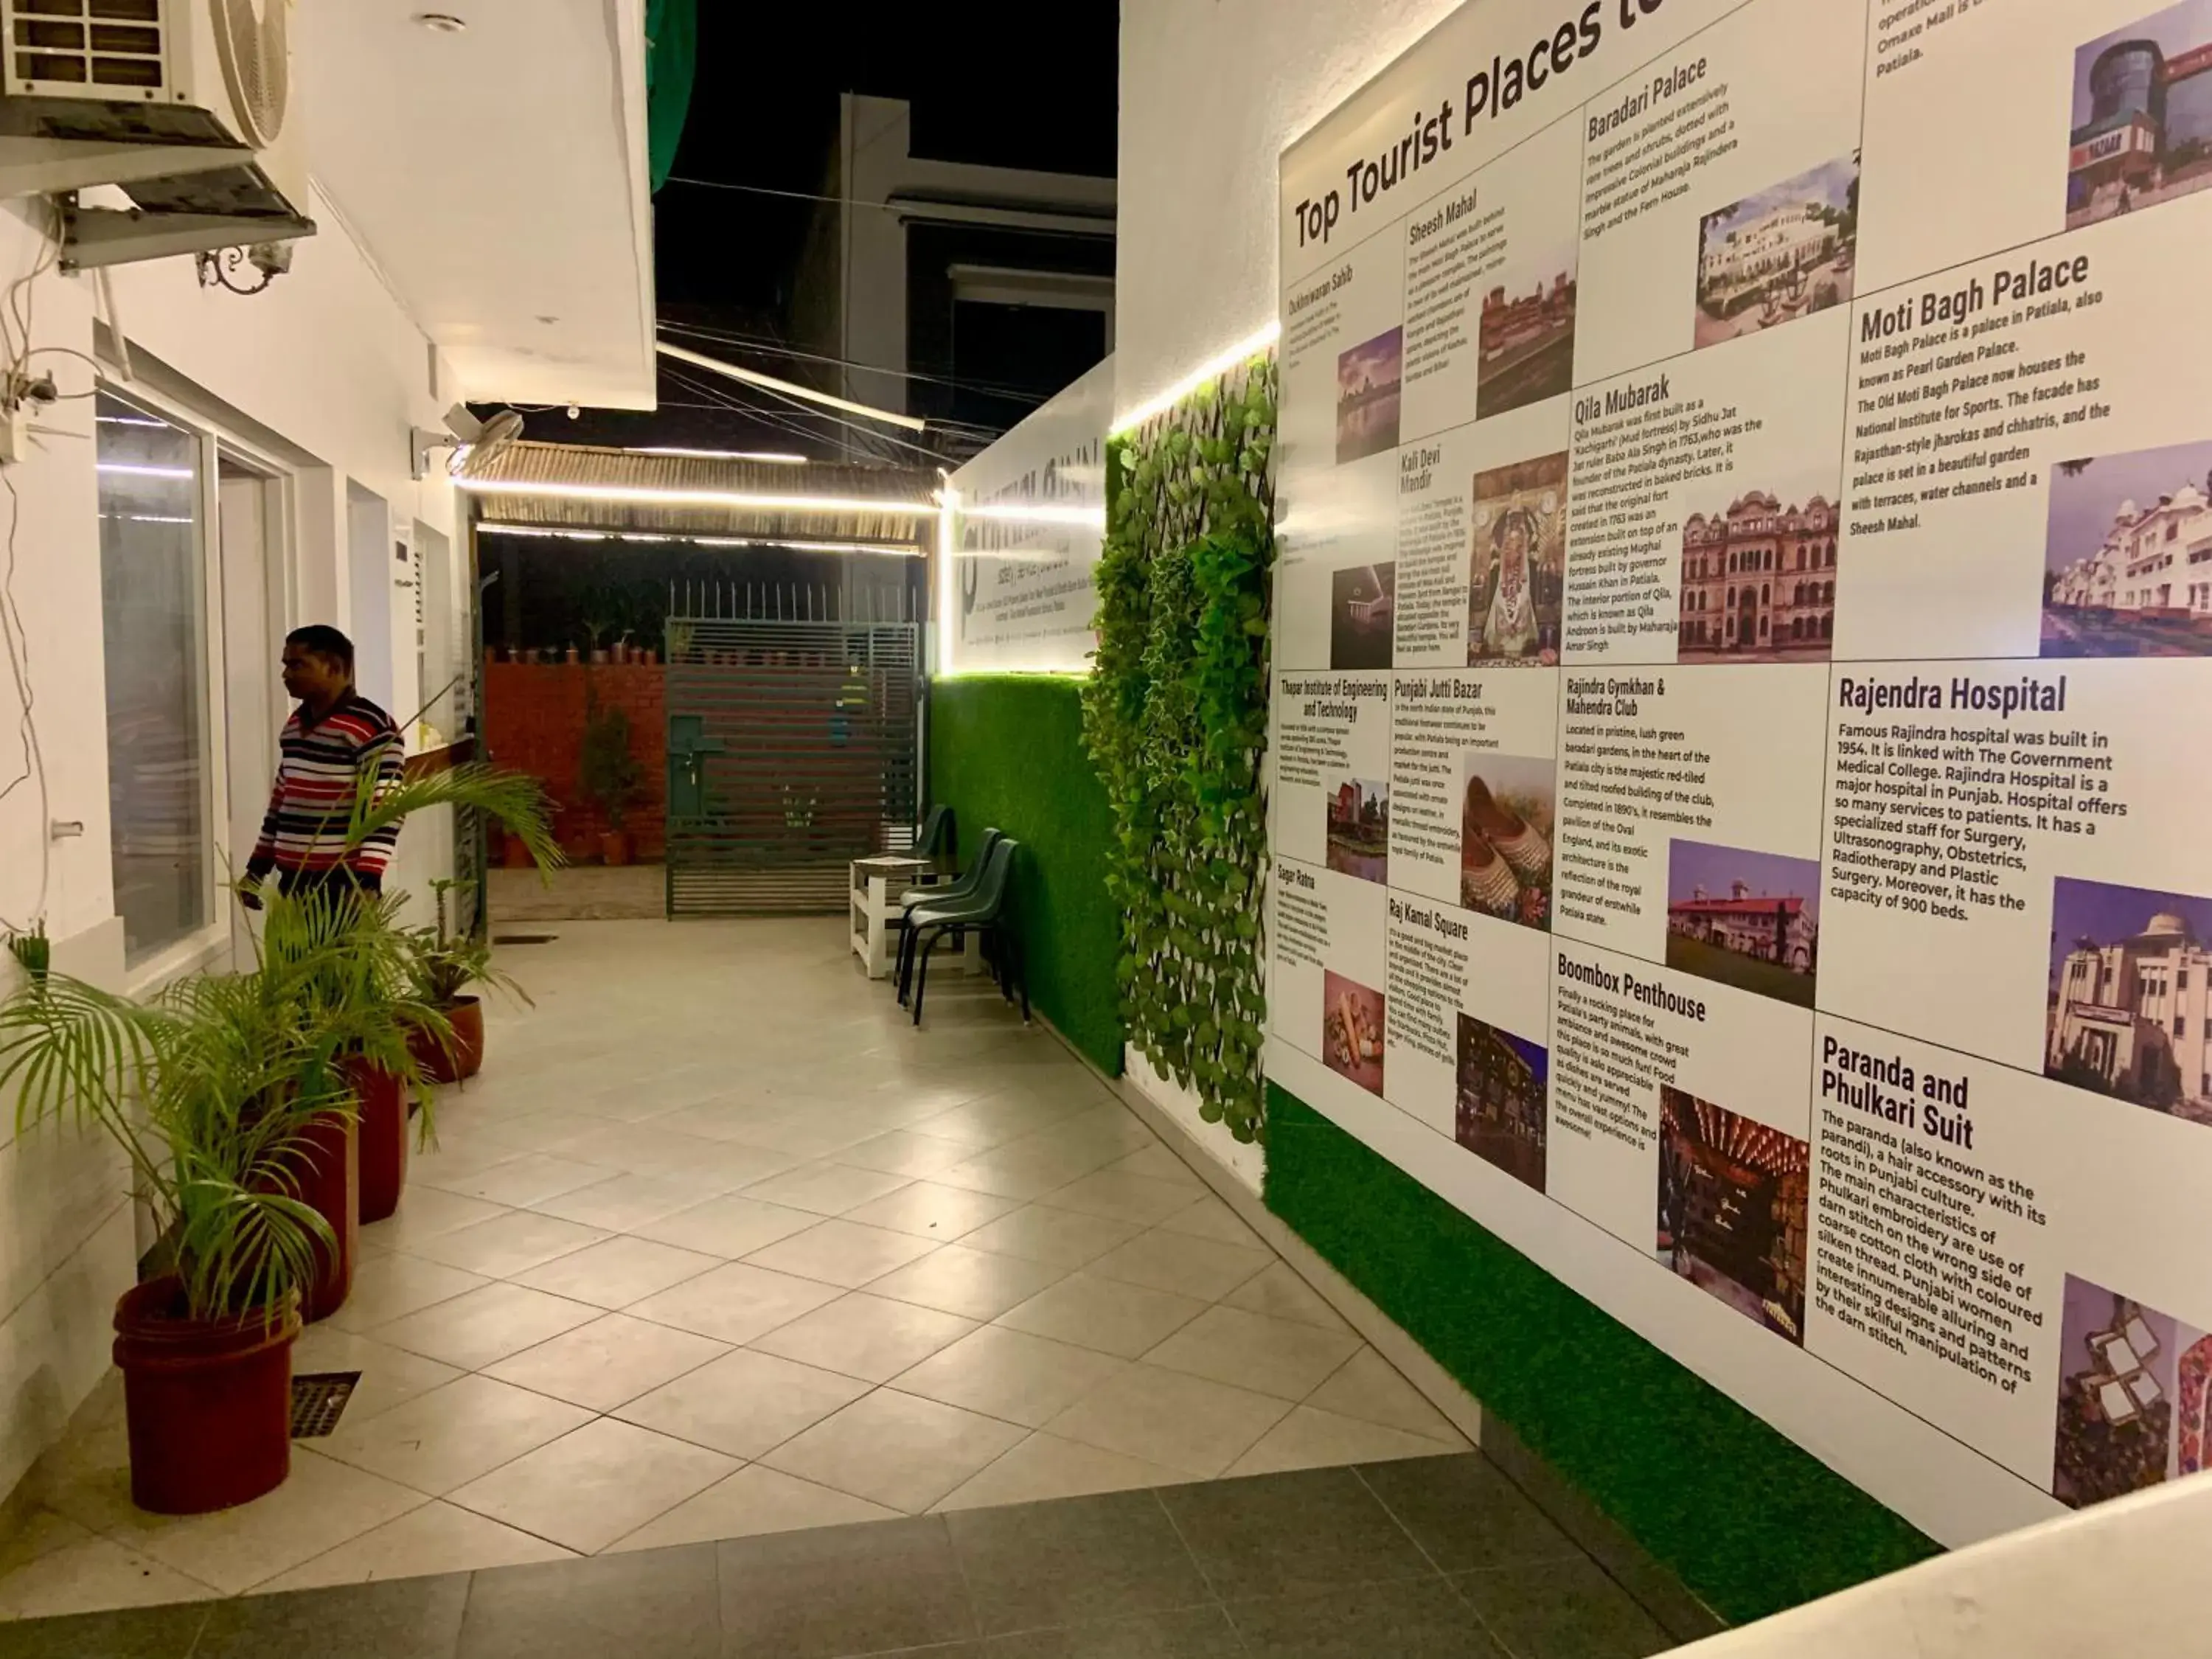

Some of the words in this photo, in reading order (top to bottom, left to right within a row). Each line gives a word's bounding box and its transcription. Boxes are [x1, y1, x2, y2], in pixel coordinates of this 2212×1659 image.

[1878, 24, 1923, 53] Omaxe
[1926, 5, 1954, 29] Mall
[1958, 1, 1968, 13] is
[1877, 47, 1923, 77] Patiala.
[1589, 85, 1648, 142] Baradari
[1653, 58, 1707, 105] Palace
[1295, 189, 1339, 247] Top
[1347, 100, 1453, 213] Tourist
[1465, 0, 1601, 136] Places
[1410, 214, 1444, 246] Sheesh
[1446, 188, 1478, 227] Mahal
[1861, 298, 1913, 342] Moti
[1921, 278, 1984, 326] Bagh
[1993, 256, 2089, 305] Palace
[1860, 344, 1882, 364] Moti
[1884, 342, 1910, 359] Bagh
[1913, 333, 1947, 351] Palace
[1950, 327, 1959, 341] is
[1962, 326, 1969, 338] a
[1972, 317, 2009, 338] palace
[2011, 311, 2023, 325] in
[2026, 301, 2071, 321] Patiala,
[2075, 289, 2103, 308] also
[1858, 375, 1890, 389] known
[1893, 369, 1905, 381] as
[1907, 358, 1933, 378] Pearl
[1936, 350, 1975, 371] Garden
[1978, 341, 2020, 361] Palace.
[1858, 397, 1875, 414] The
[1878, 390, 1894, 409] Old
[1897, 387, 1920, 406] Moti
[1923, 382, 1950, 400] Bagh
[1952, 372, 1989, 392] Palace
[1992, 369, 2015, 383] now
[2018, 356, 2062, 378] houses
[2065, 351, 2085, 366] the
[1575, 396, 1601, 425] Qila
[1606, 373, 1669, 415] Mubarak
[1402, 450, 1419, 472] Kali
[1420, 444, 1441, 467] Devi
[1401, 469, 1432, 494] Mandir
[1571, 504, 1586, 516] said
[1588, 503, 1603, 514] that
[1606, 499, 1617, 510] the
[1620, 493, 1651, 509] original
[1652, 490, 1669, 501] fort
[1850, 517, 1885, 536] Sheesh
[1887, 514, 1921, 532] Mahal.
[1281, 679, 1303, 698] Thapar
[1304, 679, 1332, 695] Institute
[1333, 679, 1340, 695] of
[1342, 679, 1387, 701] Engineering
[1395, 678, 1427, 702] Punjabi
[1430, 678, 1451, 698] Jutti
[1454, 679, 1482, 699] Bazar
[1566, 699, 1613, 716] Mahendra
[1615, 700, 1638, 717] Club
[1568, 678, 1605, 700] Rajindra
[1608, 678, 1654, 701] Gymkhan
[1657, 679, 1665, 696] &
[1840, 677, 1941, 715] Rajendra
[1950, 675, 2066, 719] Hospital
[1304, 700, 1315, 716] and
[1317, 700, 1357, 723] Technology
[1838, 723, 1888, 739] Famous
[1891, 726, 1947, 742] Rajindra
[1950, 728, 2009, 744] hospital
[2014, 733, 2044, 746] was
[2049, 731, 2087, 748] built
[2092, 732, 2108, 748] in
[1837, 742, 1868, 755] 1954.
[1871, 742, 1882, 756] It
[1884, 744, 1893, 757] is
[1897, 743, 1939, 760] linked
[1942, 747, 1975, 762] with
[1979, 748, 2006, 764] The
[2011, 751, 2112, 771] Government
[1837, 760, 1885, 775] Medical
[1888, 763, 1941, 779] College.
[1945, 768, 2005, 784] Rajindra
[2010, 771, 2075, 790] Hospital
[2080, 778, 2093, 791] is
[2098, 782, 2108, 792] a
[1564, 780, 1578, 790] and
[1579, 781, 1599, 793] tilted
[1601, 783, 1626, 796] roofed
[1627, 787, 1662, 802] building
[1664, 790, 1673, 801] of
[1675, 791, 1690, 804] the
[1692, 793, 1714, 807] club,
[1562, 817, 1591, 829] pavilion
[1593, 821, 1601, 830] of
[1602, 821, 1615, 832] the
[1618, 824, 1634, 836] Oval
[1834, 815, 1903, 833] specialized
[1907, 821, 1937, 837] staff
[1941, 825, 1960, 840] for
[1964, 828, 2026, 851] Surgery,
[1832, 849, 1916, 875] Radiotherapy
[1919, 861, 1946, 877] and
[1950, 866, 1999, 886] Plastic
[1833, 832, 1944, 860] Ultrasonography,
[1947, 847, 2026, 872] Obstetrics,
[1278, 864, 1295, 885] Sagar
[1297, 870, 1315, 889] Ratna
[1389, 898, 1403, 924] Raj
[1405, 903, 1432, 929] Kamal
[1435, 911, 1468, 939] Square
[1831, 886, 1882, 908] capacity
[1885, 895, 1899, 908] of
[1902, 898, 1927, 914] 900
[1930, 902, 1968, 921] beds.
[1558, 953, 1619, 993] Boombox
[1624, 973, 1705, 1022] Penthouse
[1558, 987, 1582, 1004] Finally
[1589, 997, 1617, 1018] rocking
[1619, 1008, 1641, 1023] place
[1643, 1014, 1655, 1028] for
[1823, 1035, 1914, 1092] Paranda
[1922, 1074, 1968, 1110] and
[1822, 1069, 1916, 1129] Phulkari
[1923, 1105, 1973, 1150] Suit
[1822, 1109, 1844, 1127] The
[1846, 1119, 1897, 1148] paranda
[1902, 1138, 1932, 1161] (also
[1936, 1150, 1984, 1180] known
[1989, 1173, 2005, 1189] as
[2008, 1180, 2035, 1200] the
[1821, 1146, 1851, 1166] roots
[1854, 1155, 1865, 1172] in
[1869, 1164, 1918, 1194] Punjabi
[1921, 1185, 1975, 1217] culture.
[1822, 1127, 1874, 1160] parandi),
[1877, 1149, 1884, 1161] a
[1888, 1152, 1913, 1172] hair
[1916, 1163, 1985, 1204] accessory
[1989, 1194, 2023, 1217] with
[2027, 1206, 2046, 1226] its
[1821, 1160, 1843, 1178] The
[1845, 1172, 1876, 1194] main
[1879, 1186, 1977, 1237] characteristics
[1980, 1230, 1997, 1245] of
[1816, 1295, 1835, 1315] the
[1837, 1308, 1865, 1332] darn
[1868, 1325, 1907, 1355] stitch.
